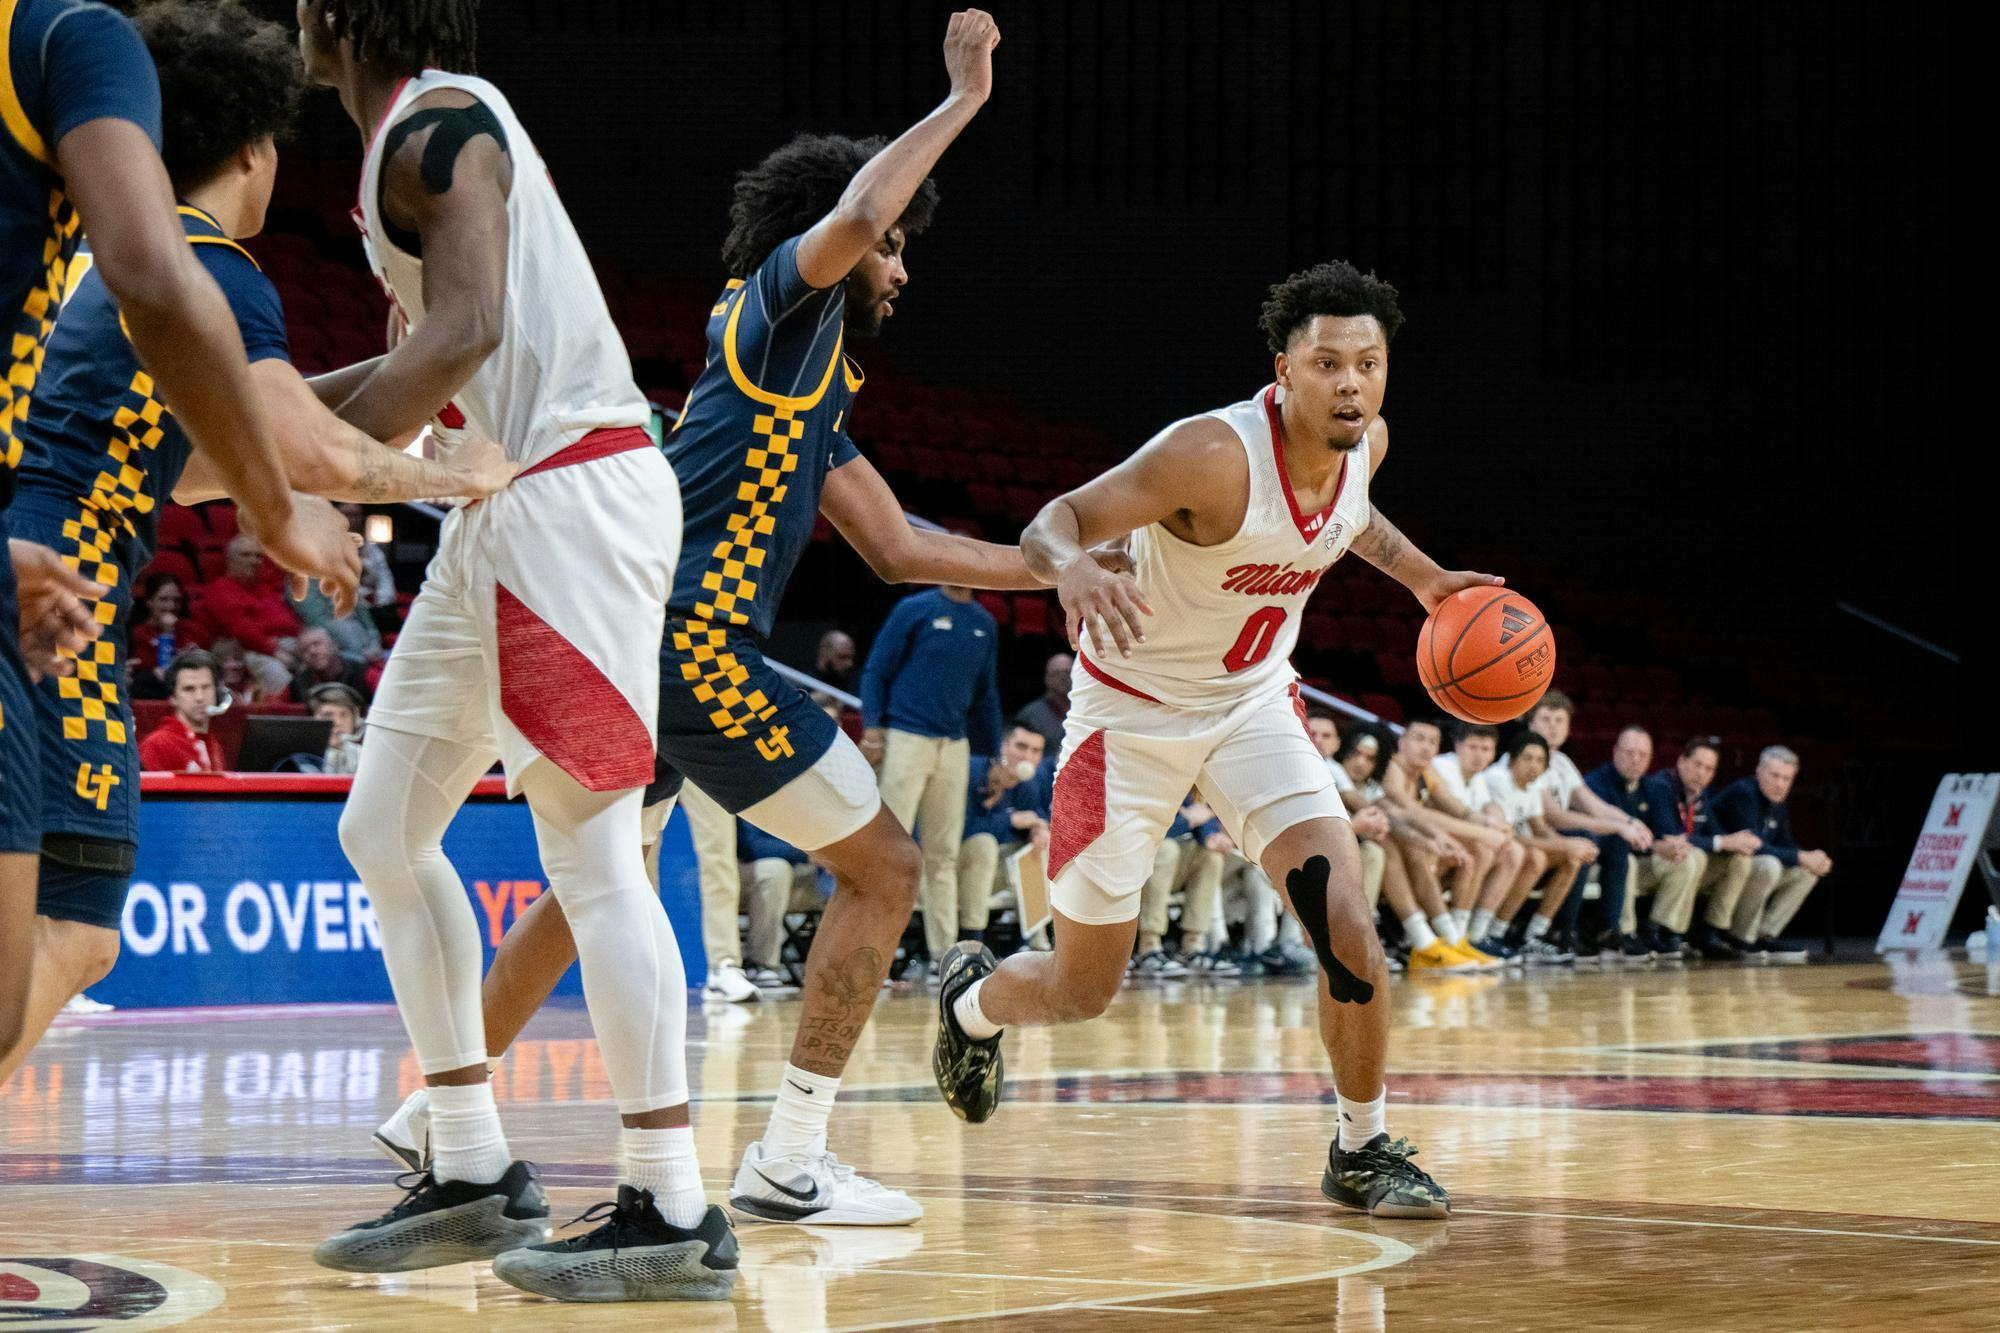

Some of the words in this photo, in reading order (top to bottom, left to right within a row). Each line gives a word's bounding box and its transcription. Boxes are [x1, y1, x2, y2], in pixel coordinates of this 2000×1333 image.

[1222, 606, 1288, 673] 0
[1515, 641, 1550, 675] PRO
[224, 880, 384, 954] OVER
